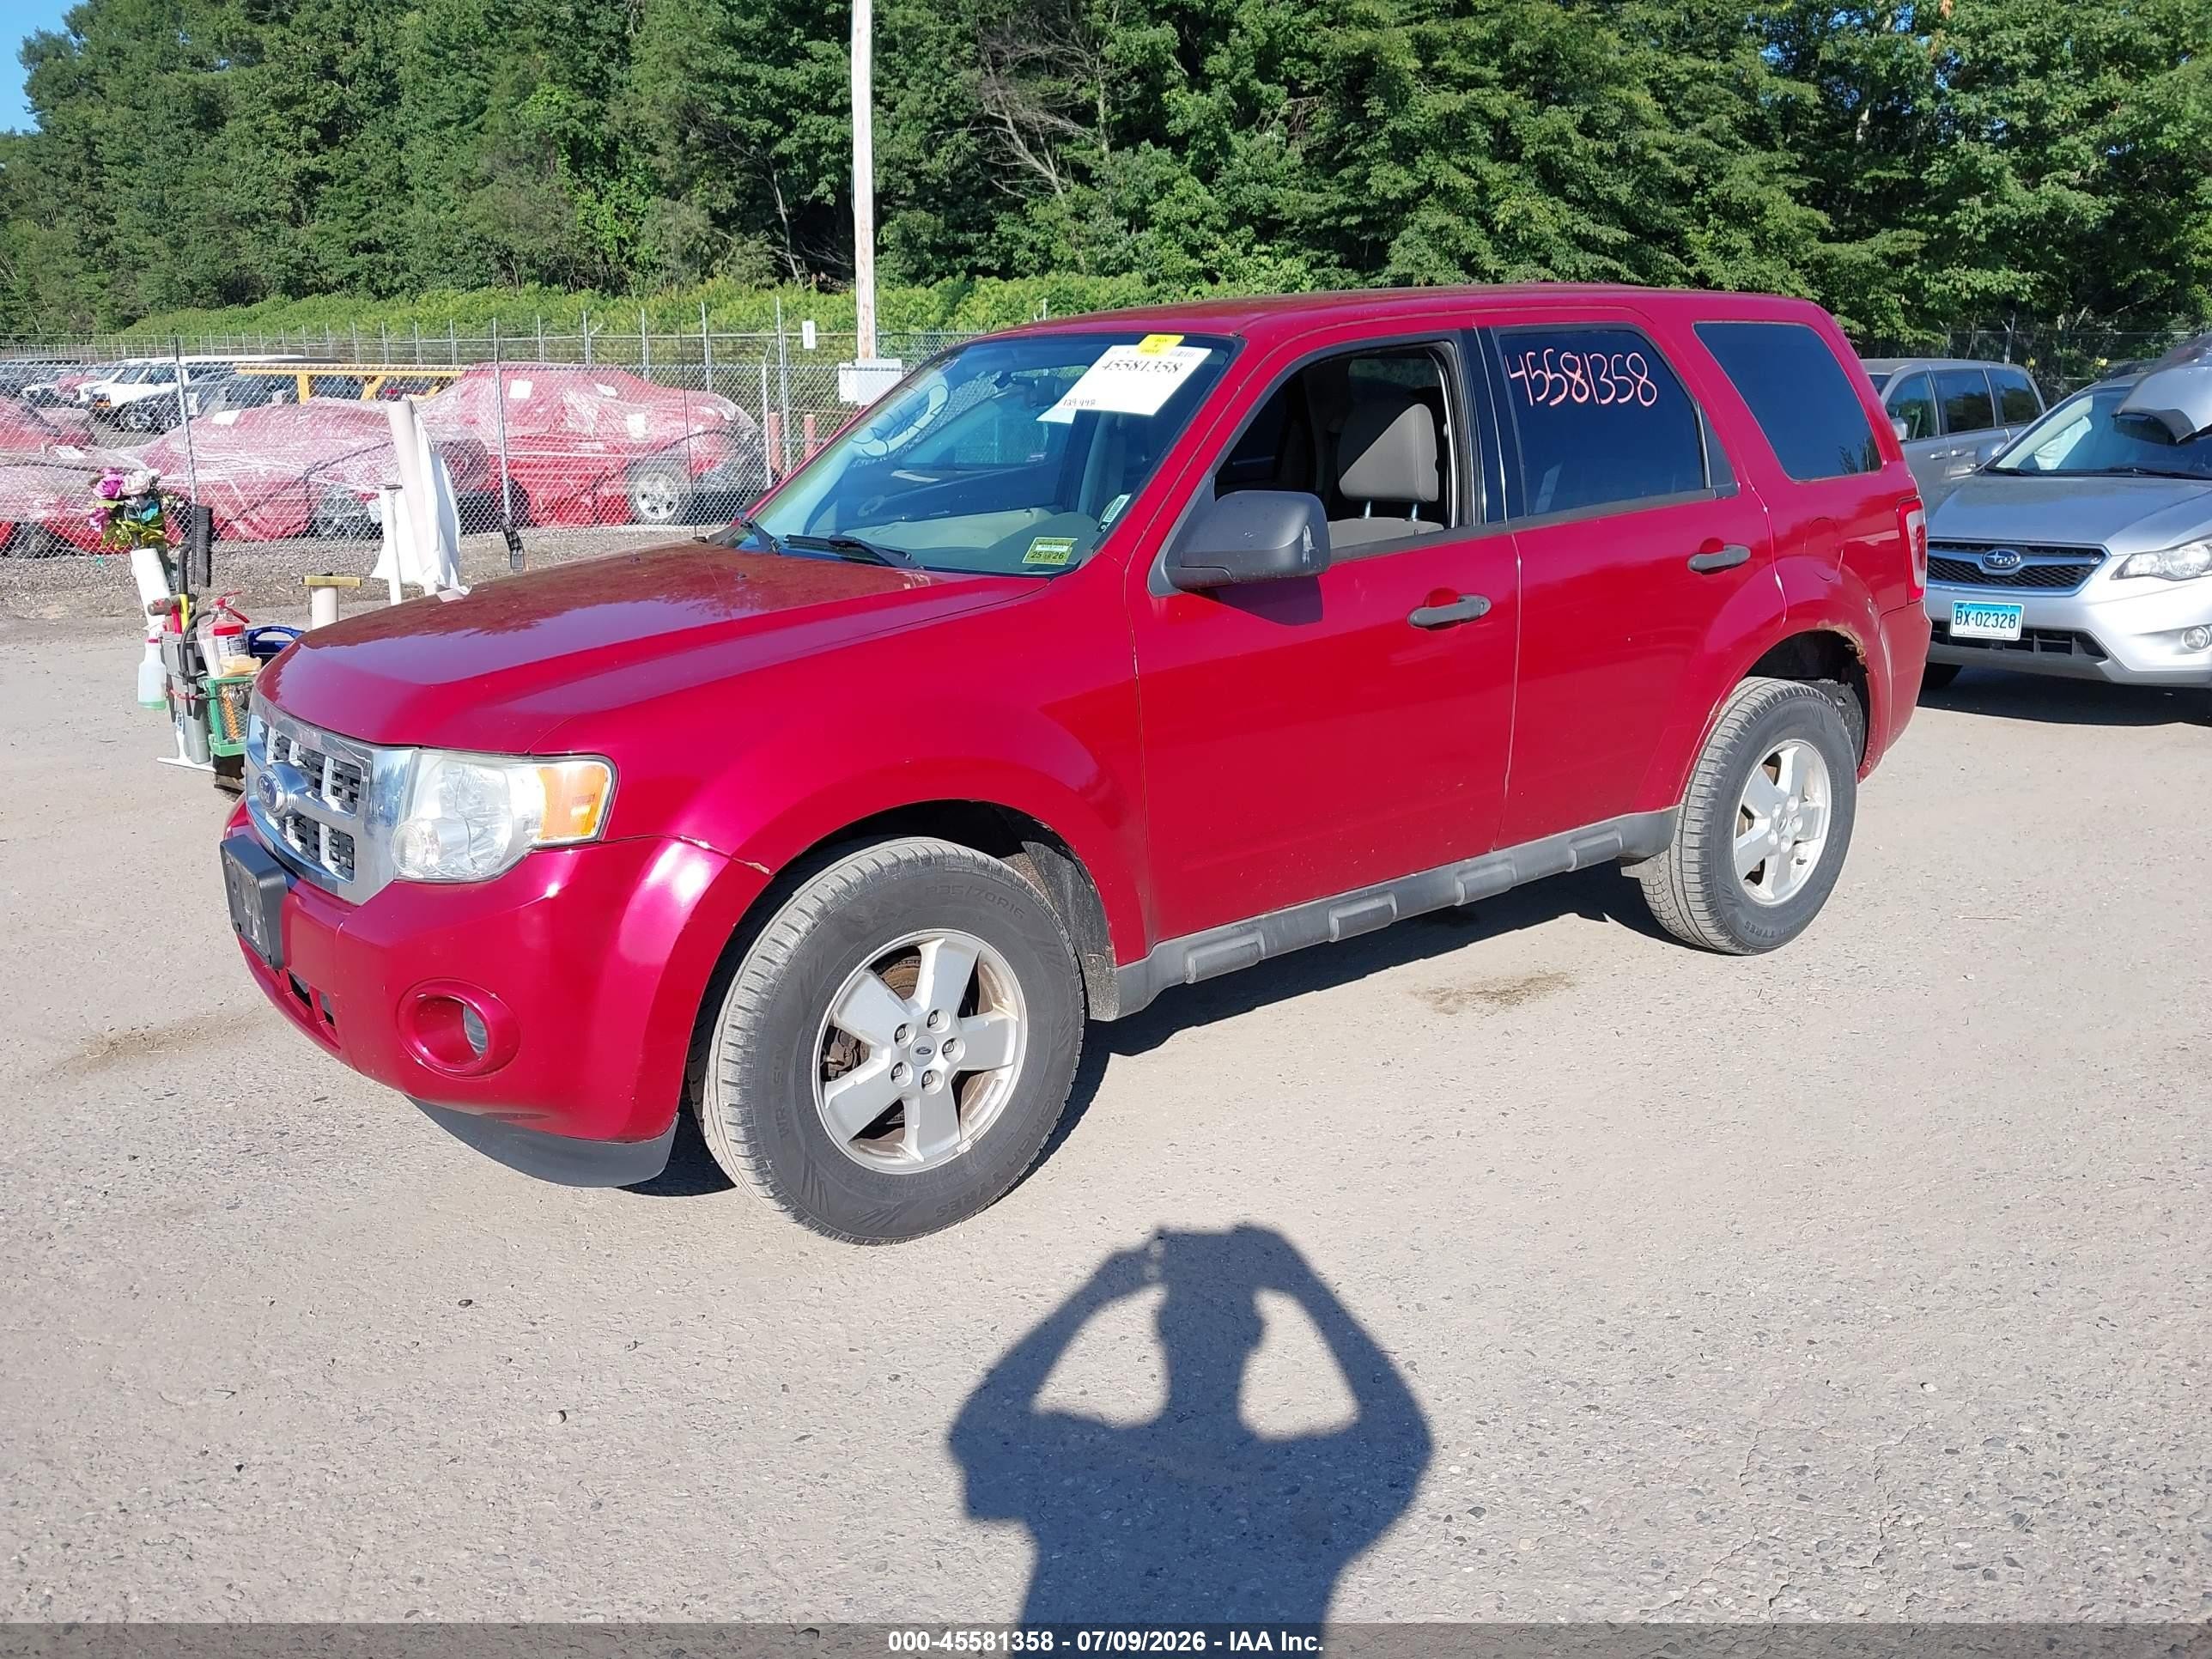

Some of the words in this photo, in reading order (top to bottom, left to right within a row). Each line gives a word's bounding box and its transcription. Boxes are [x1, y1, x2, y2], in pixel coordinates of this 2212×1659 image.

[1102, 359, 1183, 374] 45581358
[1504, 348, 1657, 407] 45581358
[1052, 551, 1066, 560] 26
